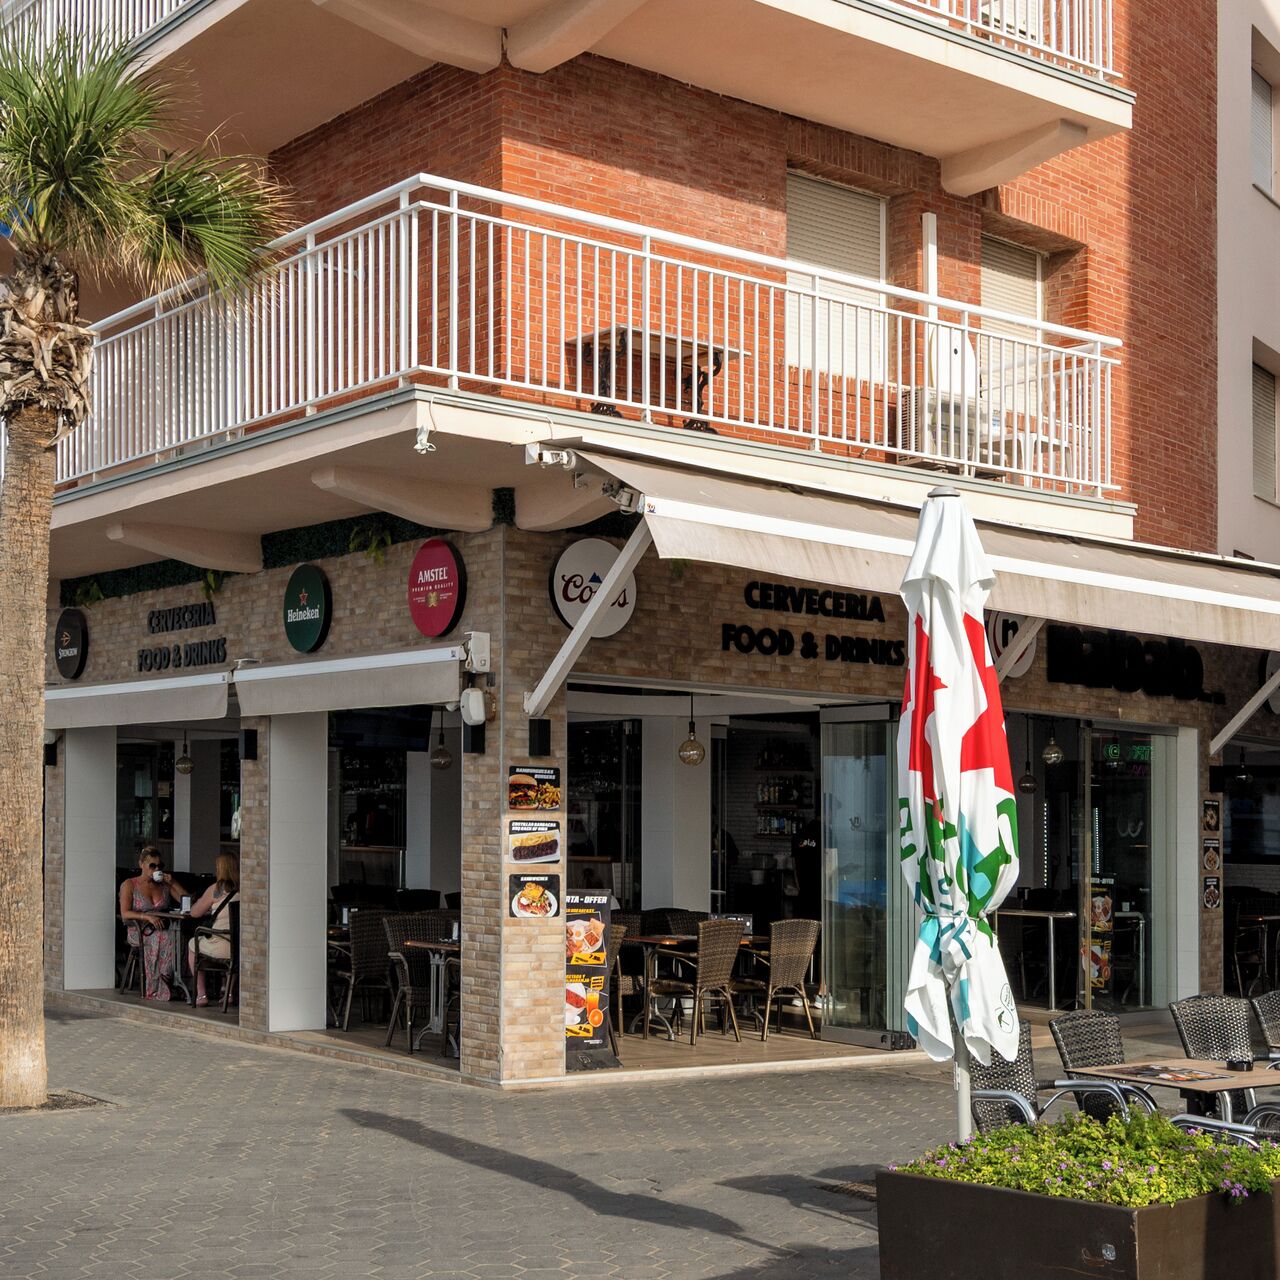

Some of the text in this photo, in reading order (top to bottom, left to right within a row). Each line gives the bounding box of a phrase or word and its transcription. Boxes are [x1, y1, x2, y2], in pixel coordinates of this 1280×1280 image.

[418, 567, 448, 584] AMSTEL
[561, 574, 629, 608] Cos
[147, 602, 217, 633] CERVECERIA
[287, 607, 320, 622] Heineken
[744, 581, 885, 622] CERVECERIA
[137, 637, 227, 671] FOOD & DRINKS
[722, 623, 905, 665] FOOD & DRINKS
[584, 896, 607, 904] OFFER
